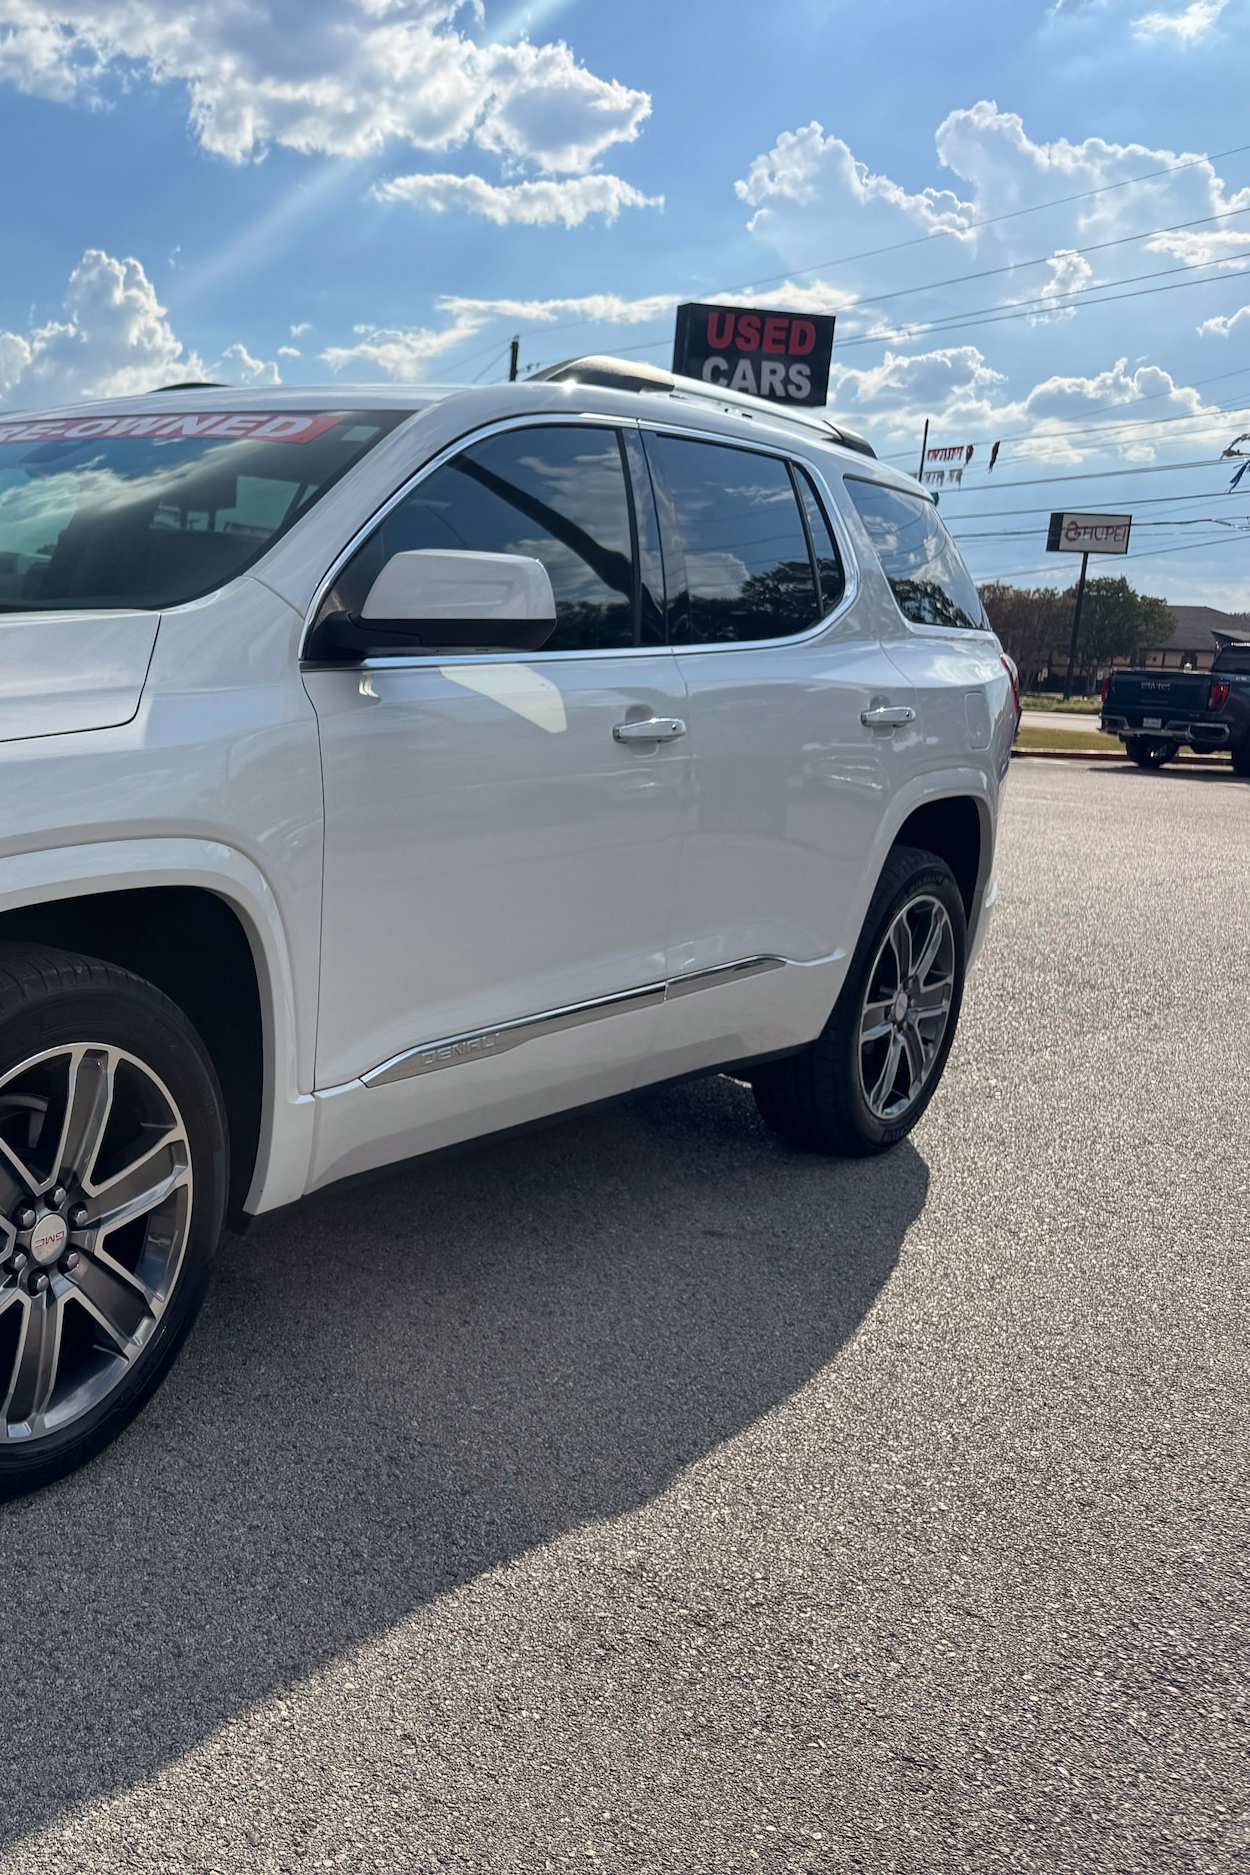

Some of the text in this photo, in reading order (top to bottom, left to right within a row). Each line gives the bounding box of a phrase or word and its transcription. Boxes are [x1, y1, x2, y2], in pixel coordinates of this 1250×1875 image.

[706, 312, 816, 356] USED
[702, 356, 812, 399] CARS
[421, 1032, 500, 1066] DENALI
[34, 1230, 65, 1249] GMC
